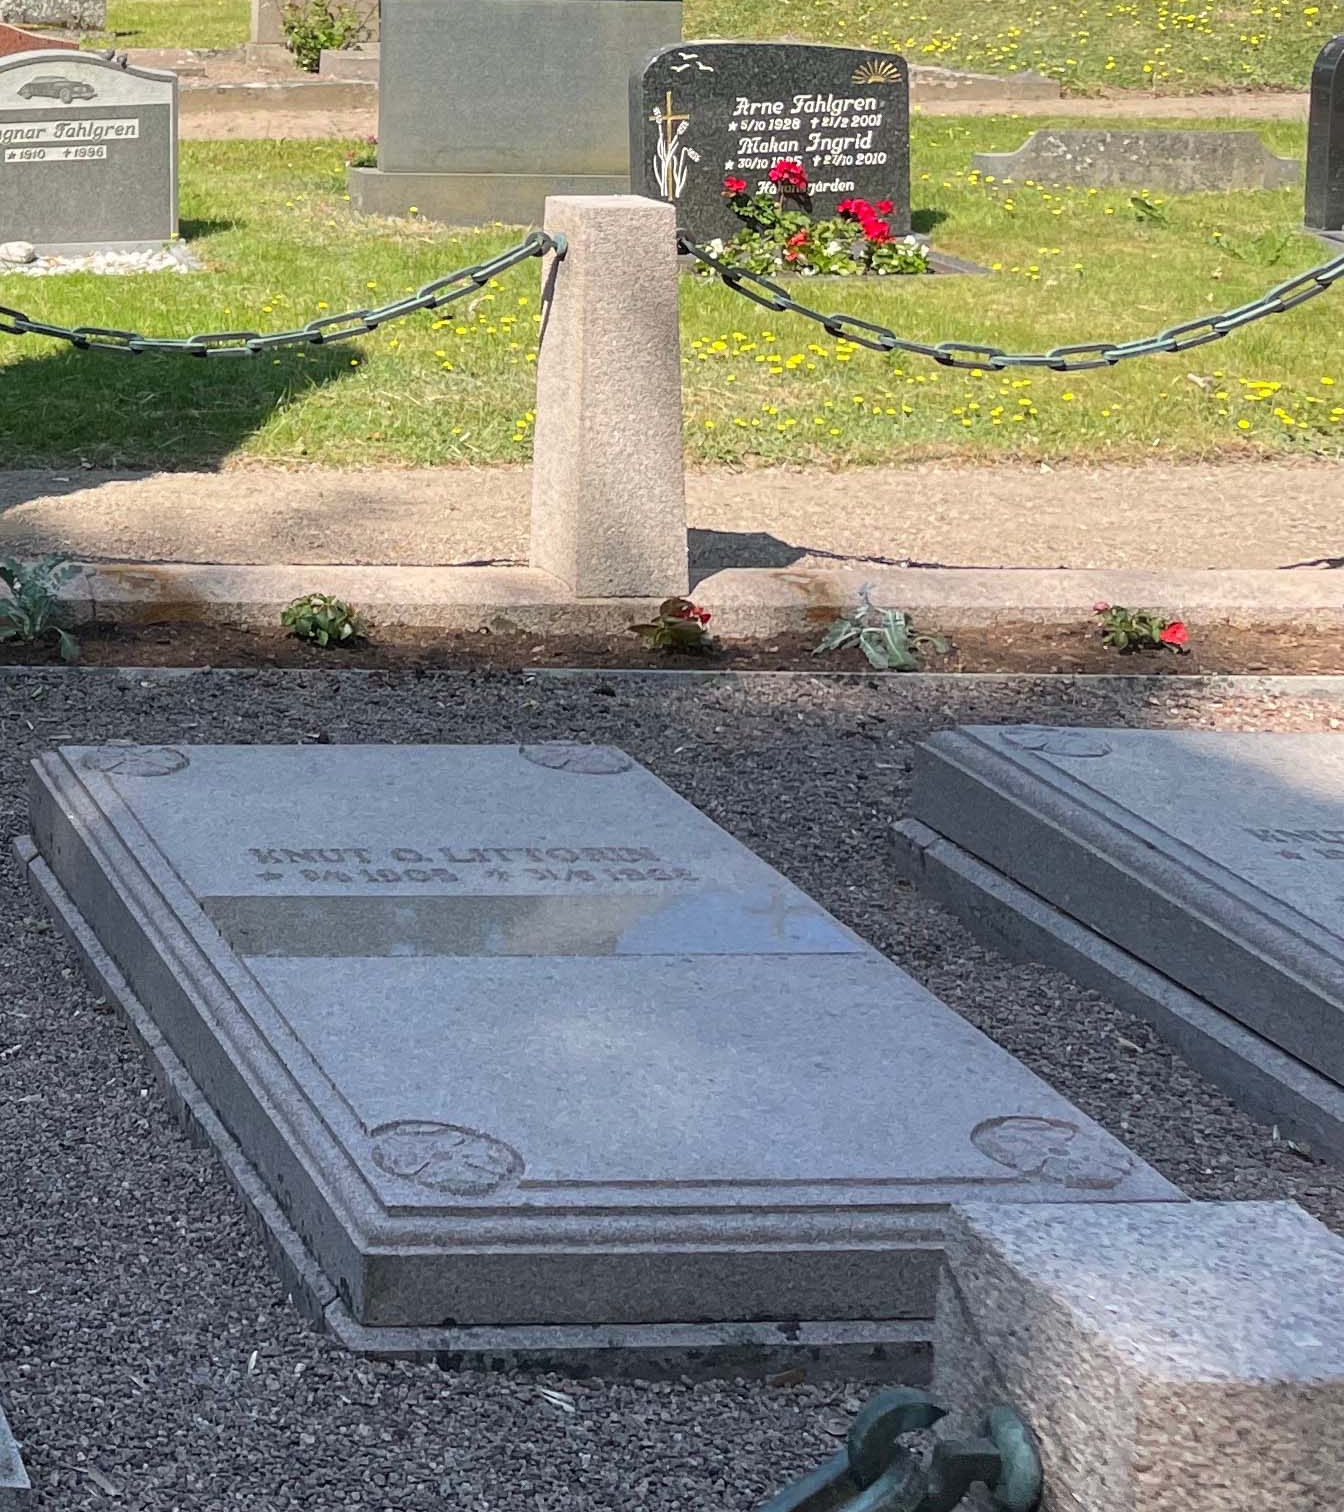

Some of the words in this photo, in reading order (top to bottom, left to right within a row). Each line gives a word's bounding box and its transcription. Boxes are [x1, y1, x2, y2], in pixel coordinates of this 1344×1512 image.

[733, 96, 785, 117] Arne
[791, 94, 877, 117] Fahlgren
[53, 120, 137, 143] Fahlgren
[768, 118, 801, 131] 1928
[851, 114, 883, 129] 2001
[737, 135, 799, 155] Makan
[806, 130, 874, 155] Ingrid
[20, 147, 46, 160] 1910
[74, 146, 105, 159] 1996
[855, 152, 887, 166] 2010
[248, 847, 372, 865] KNUT
[389, 847, 434, 864] O.
[437, 846, 661, 864] LITTORIN
